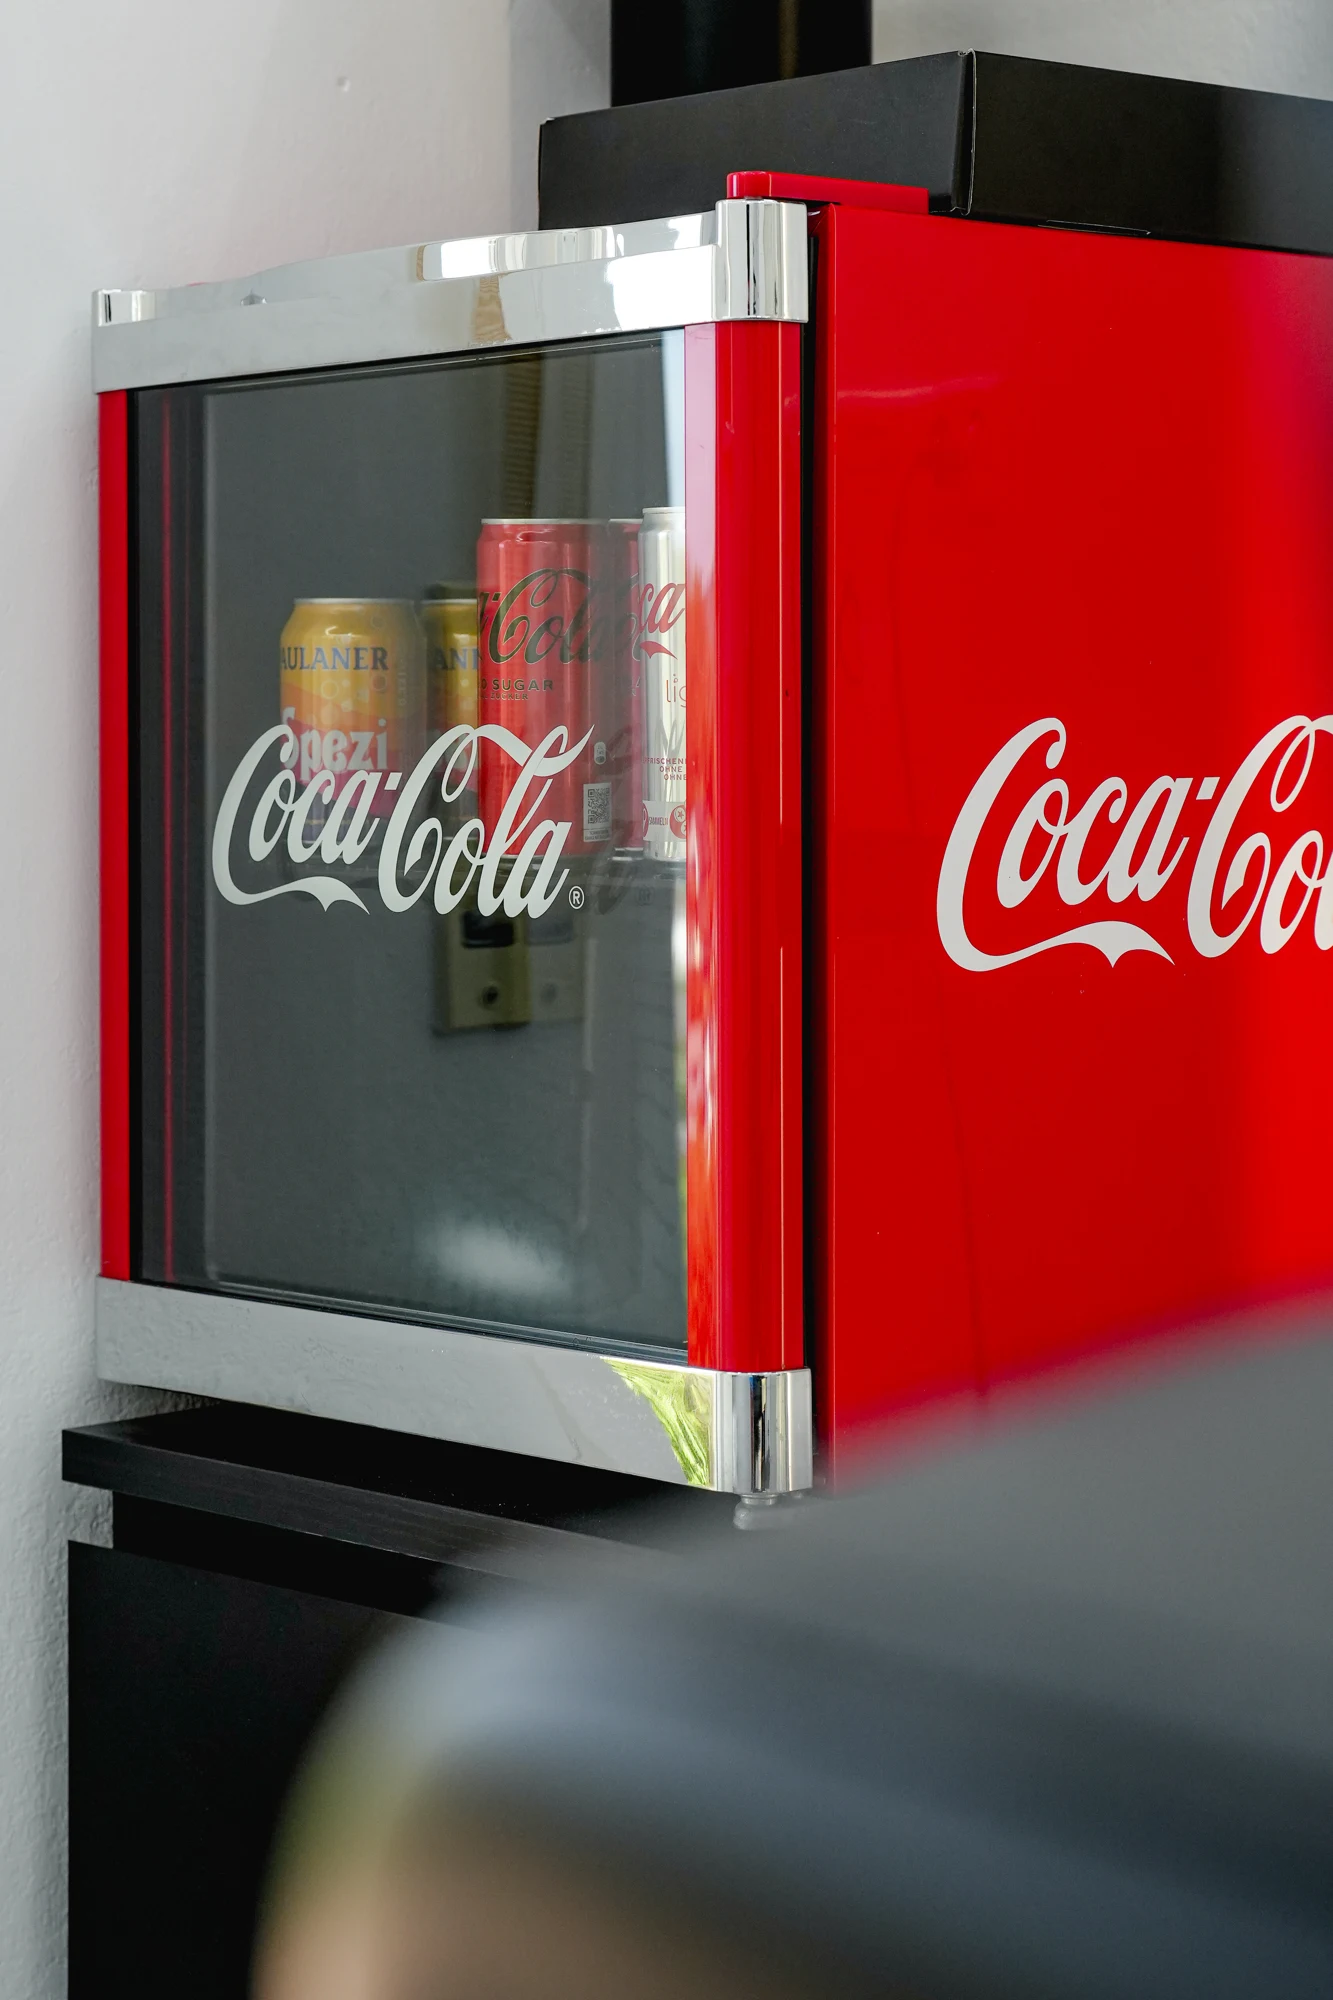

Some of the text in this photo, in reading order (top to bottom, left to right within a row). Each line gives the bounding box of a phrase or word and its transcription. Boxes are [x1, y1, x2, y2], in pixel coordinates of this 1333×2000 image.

[490, 692, 529, 700] ZUCKER
[492, 678, 554, 691] SUGAR
[212, 724, 595, 919] Coca-Cola
[936, 714, 1333, 973] Coca-Co
